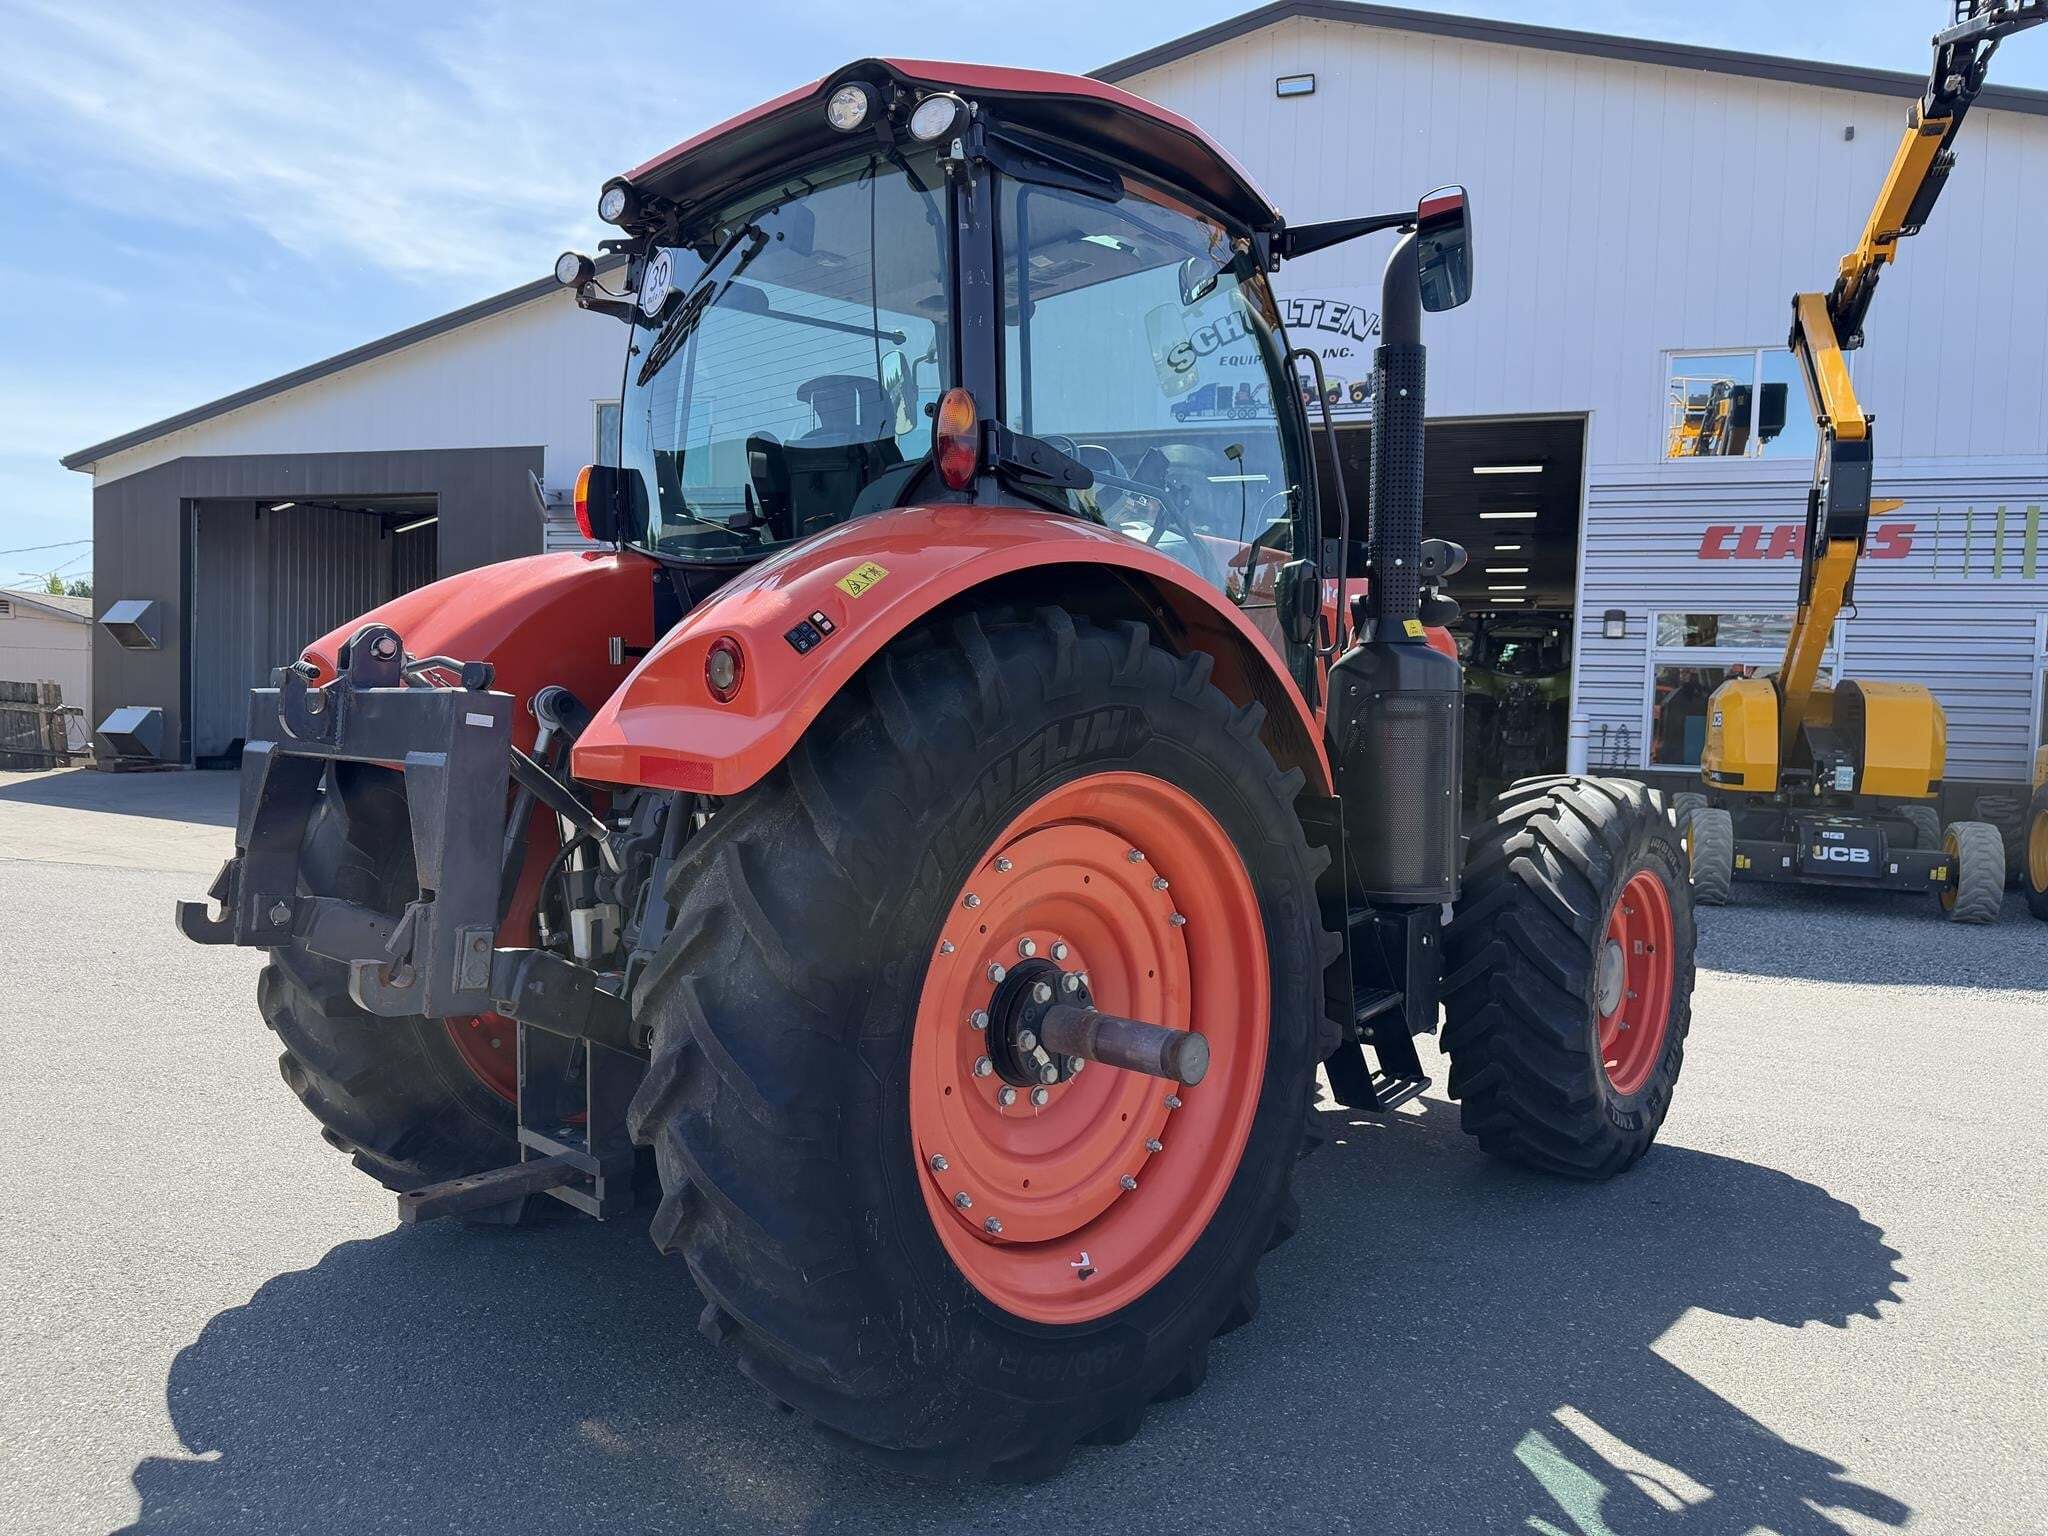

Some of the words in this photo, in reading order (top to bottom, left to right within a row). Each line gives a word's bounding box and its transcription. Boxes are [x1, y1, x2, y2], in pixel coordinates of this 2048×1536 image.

[650, 261, 668, 292] 30
[1167, 298, 1381, 374] SCHLTEN
[1322, 347, 1355, 359] INC.
[1697, 524, 1916, 560] CLAS
[1812, 846, 1870, 863] JCB
